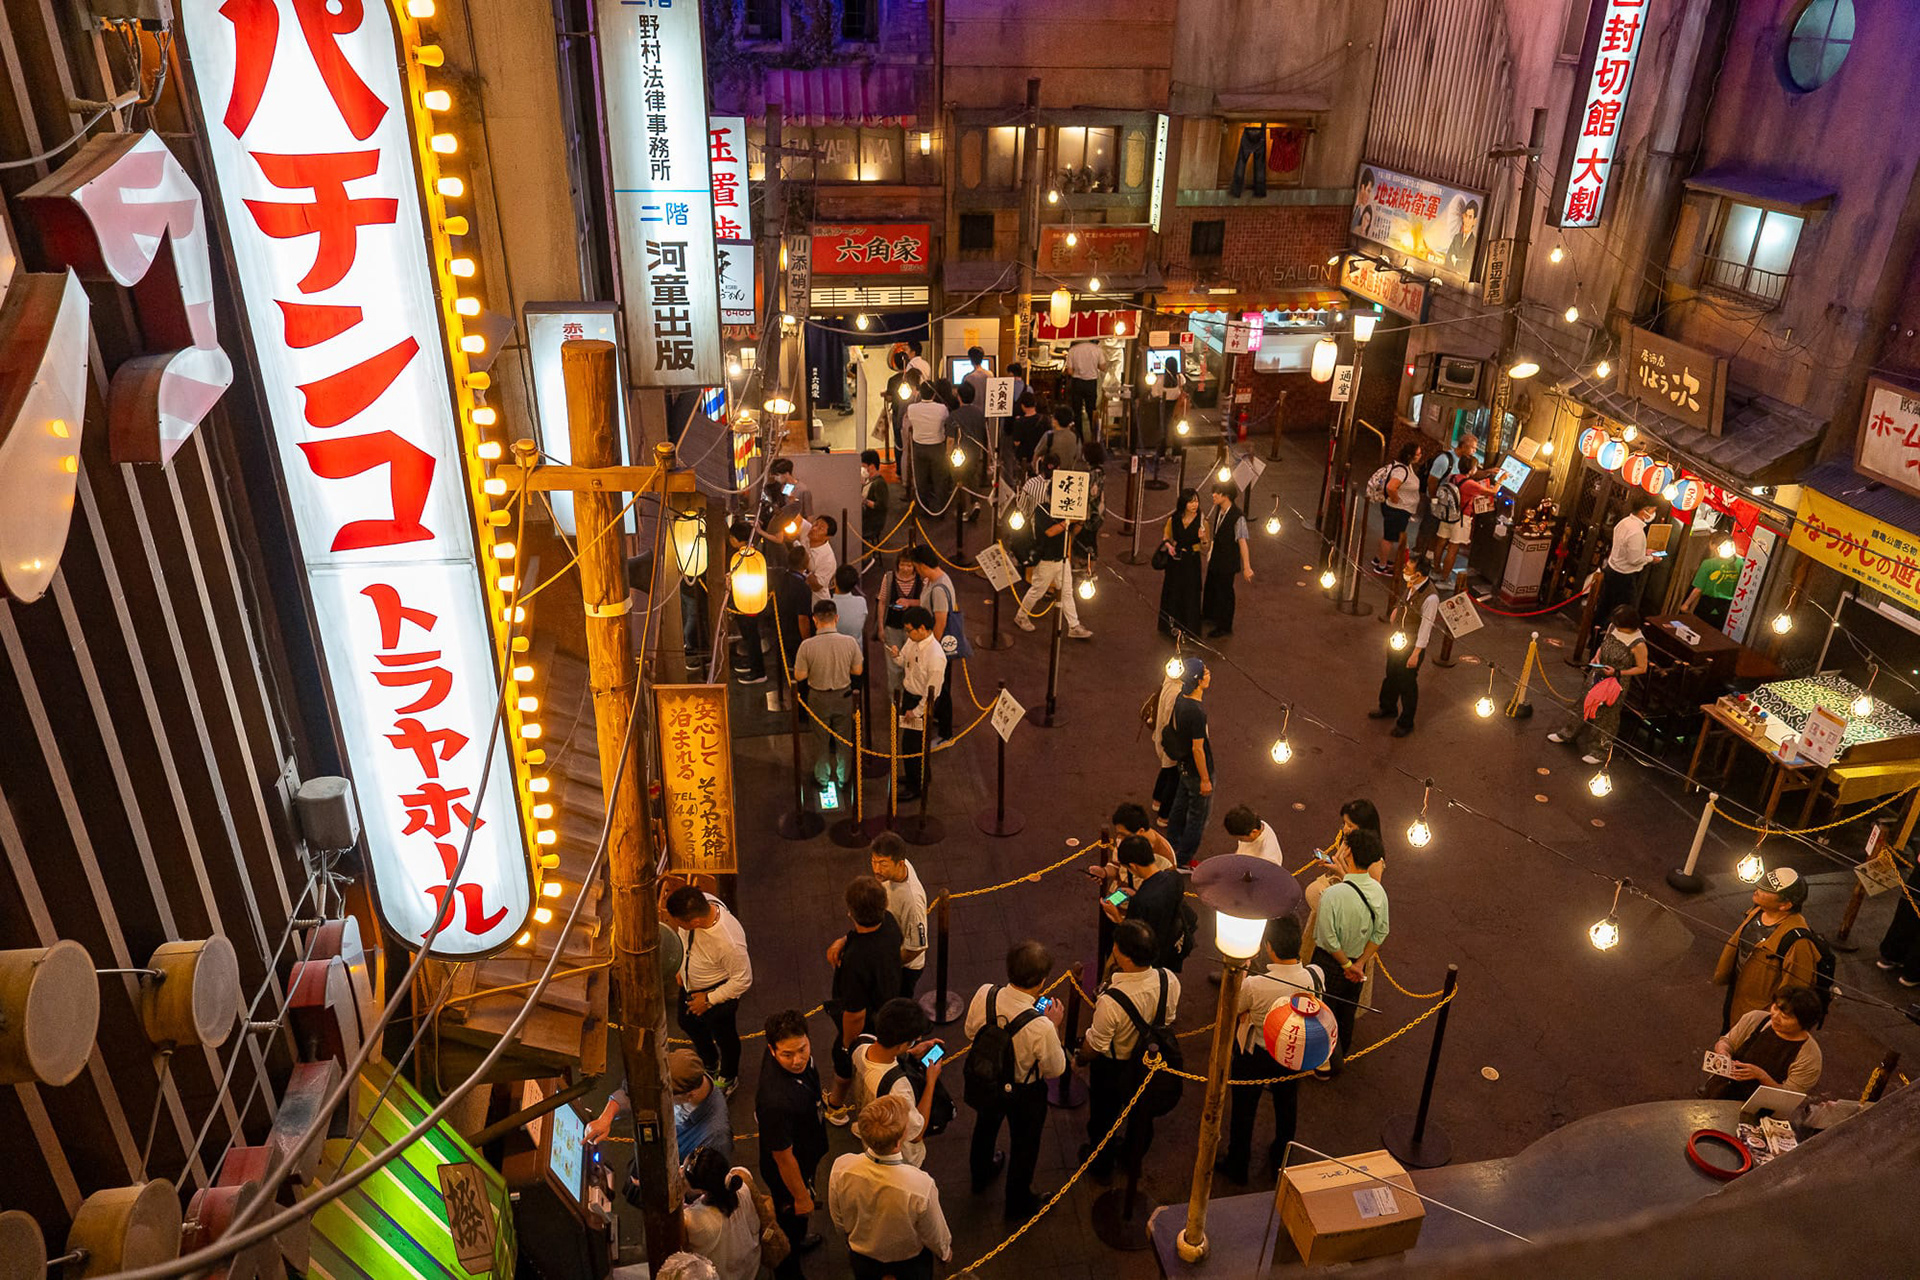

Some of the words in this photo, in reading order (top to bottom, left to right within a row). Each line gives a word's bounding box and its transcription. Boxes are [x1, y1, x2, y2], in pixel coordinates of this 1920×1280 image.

[639, 14, 671, 181] 野村法律事務所
[1583, 0, 1644, 137] 封切館
[640, 202, 689, 226] 二階
[1374, 181, 1442, 221] 地球防衛軍
[1565, 148, 1609, 222] 大劇
[836, 236, 922, 264] 六角家
[1274, 264, 1332, 281] SALON
[646, 240, 695, 371] 河童出版
[997, 381, 1008, 411] 六角家
[218, 0, 437, 552] パチンコ
[360, 583, 509, 939] トラヤホール
[668, 707, 697, 780] 泊まれる
[693, 700, 721, 766] 安心して
[672, 803, 699, 816] (44)
[674, 792, 697, 801] TEL
[698, 776, 727, 859] そうや旅館
